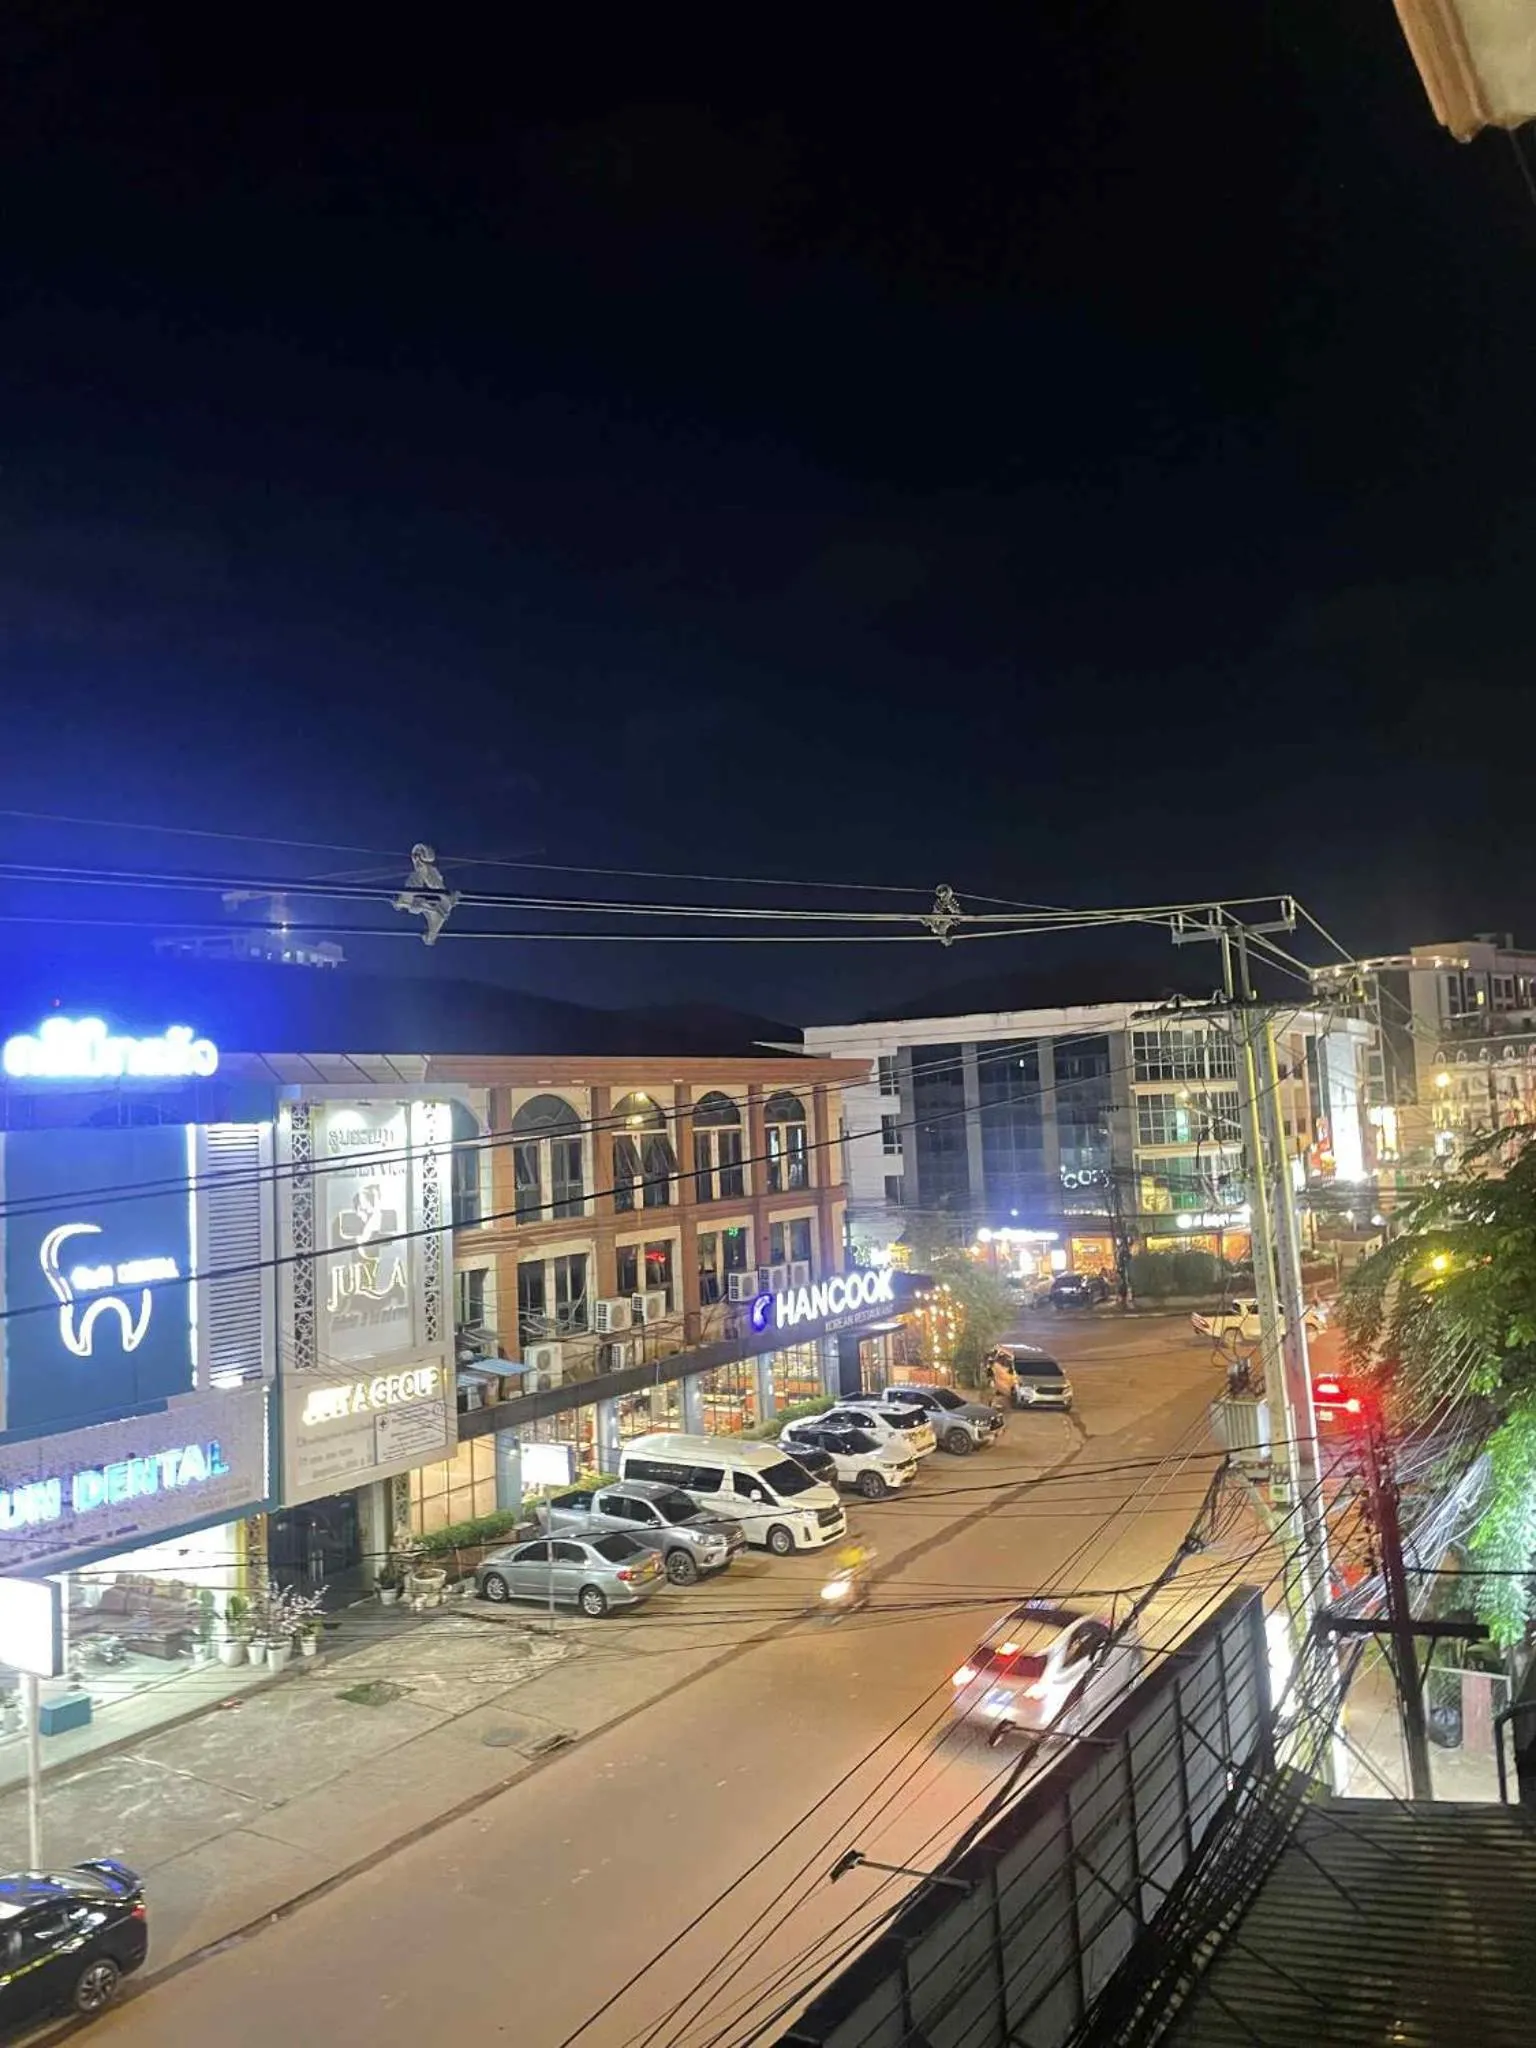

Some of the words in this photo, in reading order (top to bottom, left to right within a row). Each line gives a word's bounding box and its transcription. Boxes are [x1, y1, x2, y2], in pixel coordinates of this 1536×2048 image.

[327, 1262, 387, 1312] JULY
[776, 1268, 895, 1329] HANCOOK
[369, 1366, 440, 1408] GROUP
[72, 1440, 229, 1513] DENTAL
